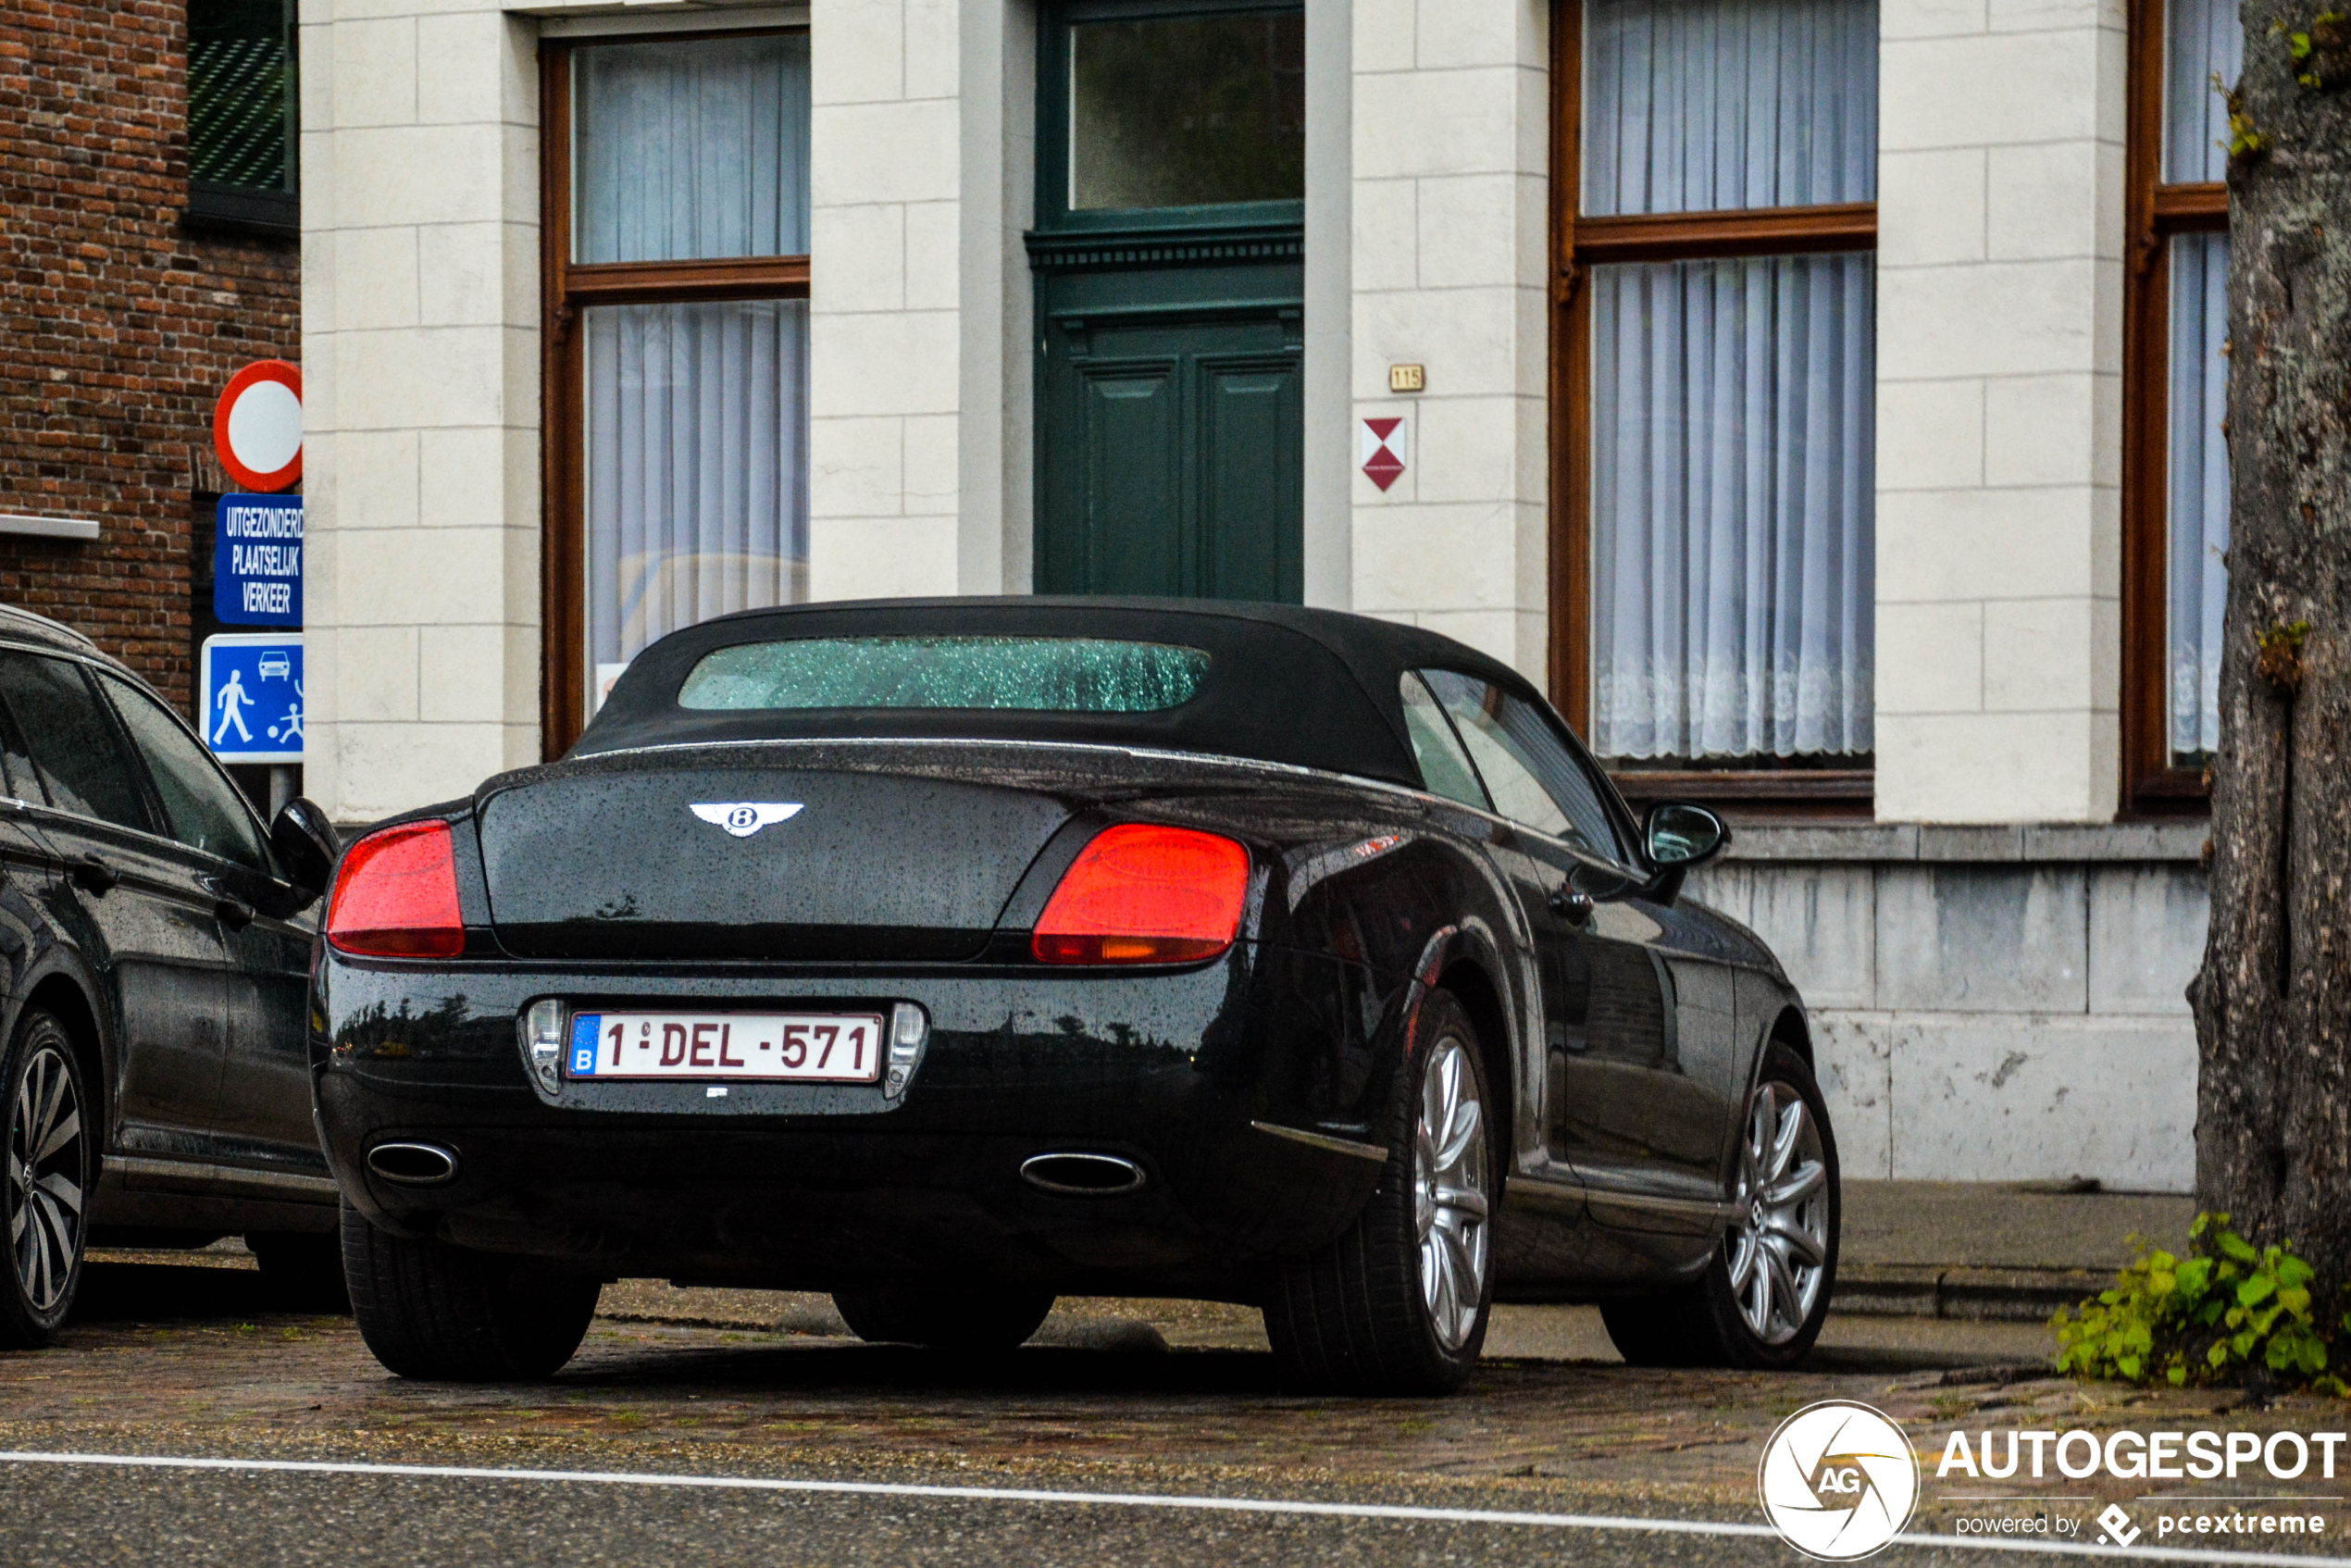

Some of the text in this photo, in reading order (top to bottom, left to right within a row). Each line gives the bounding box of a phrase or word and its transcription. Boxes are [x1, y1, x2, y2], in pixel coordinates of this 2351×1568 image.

[1394, 370, 1420, 386] 115
[227, 506, 304, 538] UITGEZONDERD
[232, 544, 299, 576] PLAATSELIJK
[243, 581, 291, 614] VERKEER
[576, 1050, 592, 1070] B
